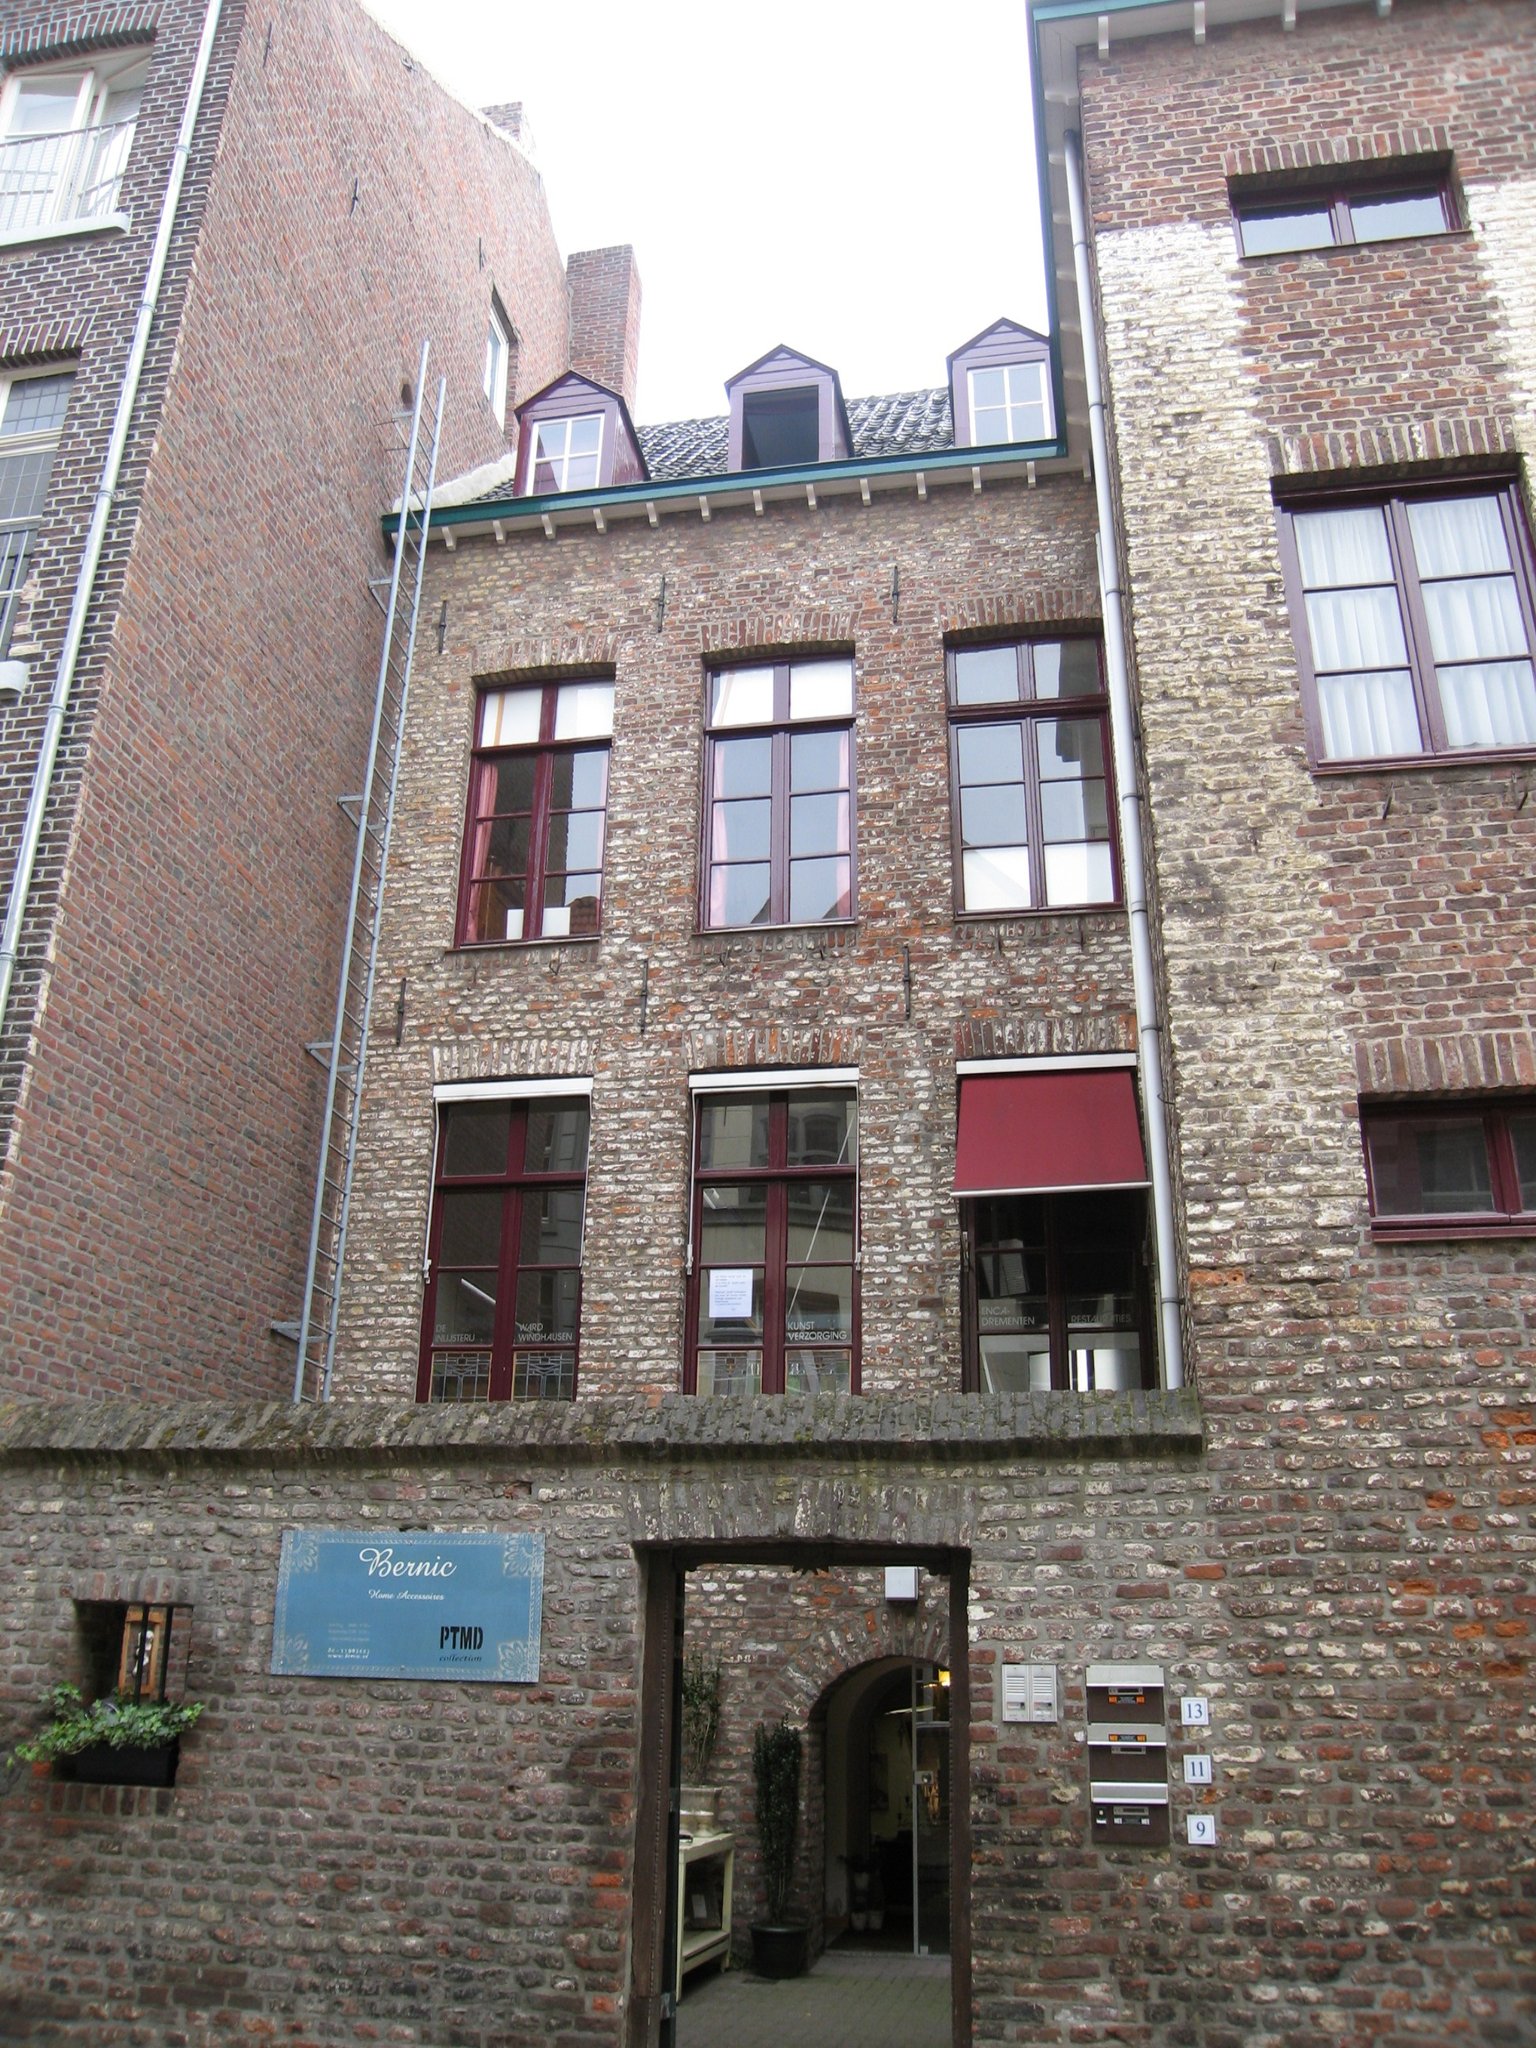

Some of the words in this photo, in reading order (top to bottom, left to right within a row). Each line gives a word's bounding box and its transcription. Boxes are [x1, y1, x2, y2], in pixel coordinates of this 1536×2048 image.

[787, 1321, 815, 1330] KUNST
[981, 1316, 1035, 1326] DREMENTEN
[520, 1323, 544, 1332] WARD
[518, 1332, 573, 1341] WINDHAUSEN
[787, 1331, 847, 1340] VERZORGING
[359, 1548, 457, 1577] Bernic
[368, 1589, 394, 1600] Home
[397, 1590, 445, 1600] Accessoires
[440, 1626, 483, 1649] PTMD
[1187, 1703, 1203, 1719] 13
[1191, 1761, 1205, 1777] 11
[1196, 1821, 1206, 1837] 9
